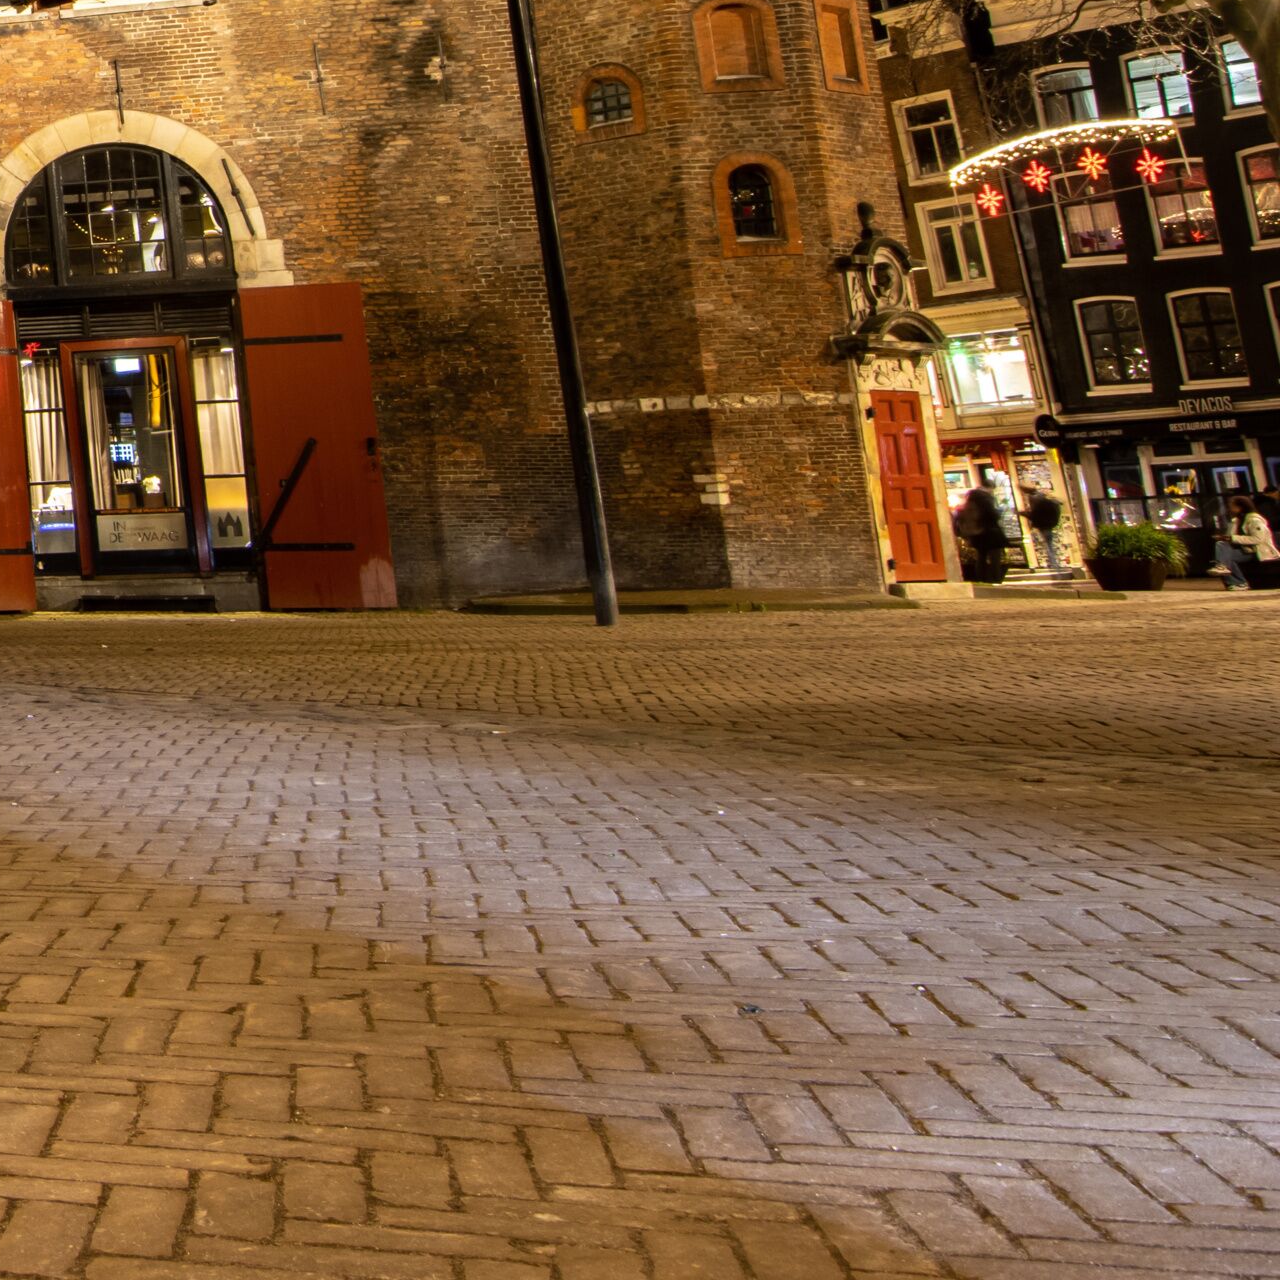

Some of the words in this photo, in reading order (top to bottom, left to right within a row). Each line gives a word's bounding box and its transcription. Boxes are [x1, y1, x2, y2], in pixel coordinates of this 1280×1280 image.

[1179, 396, 1232, 415] DEYACOS
[1168, 421, 1213, 431] RESTAURANT
[1222, 419, 1237, 429] BAR
[113, 521, 126, 532] IN
[137, 531, 179, 542] WAAG
